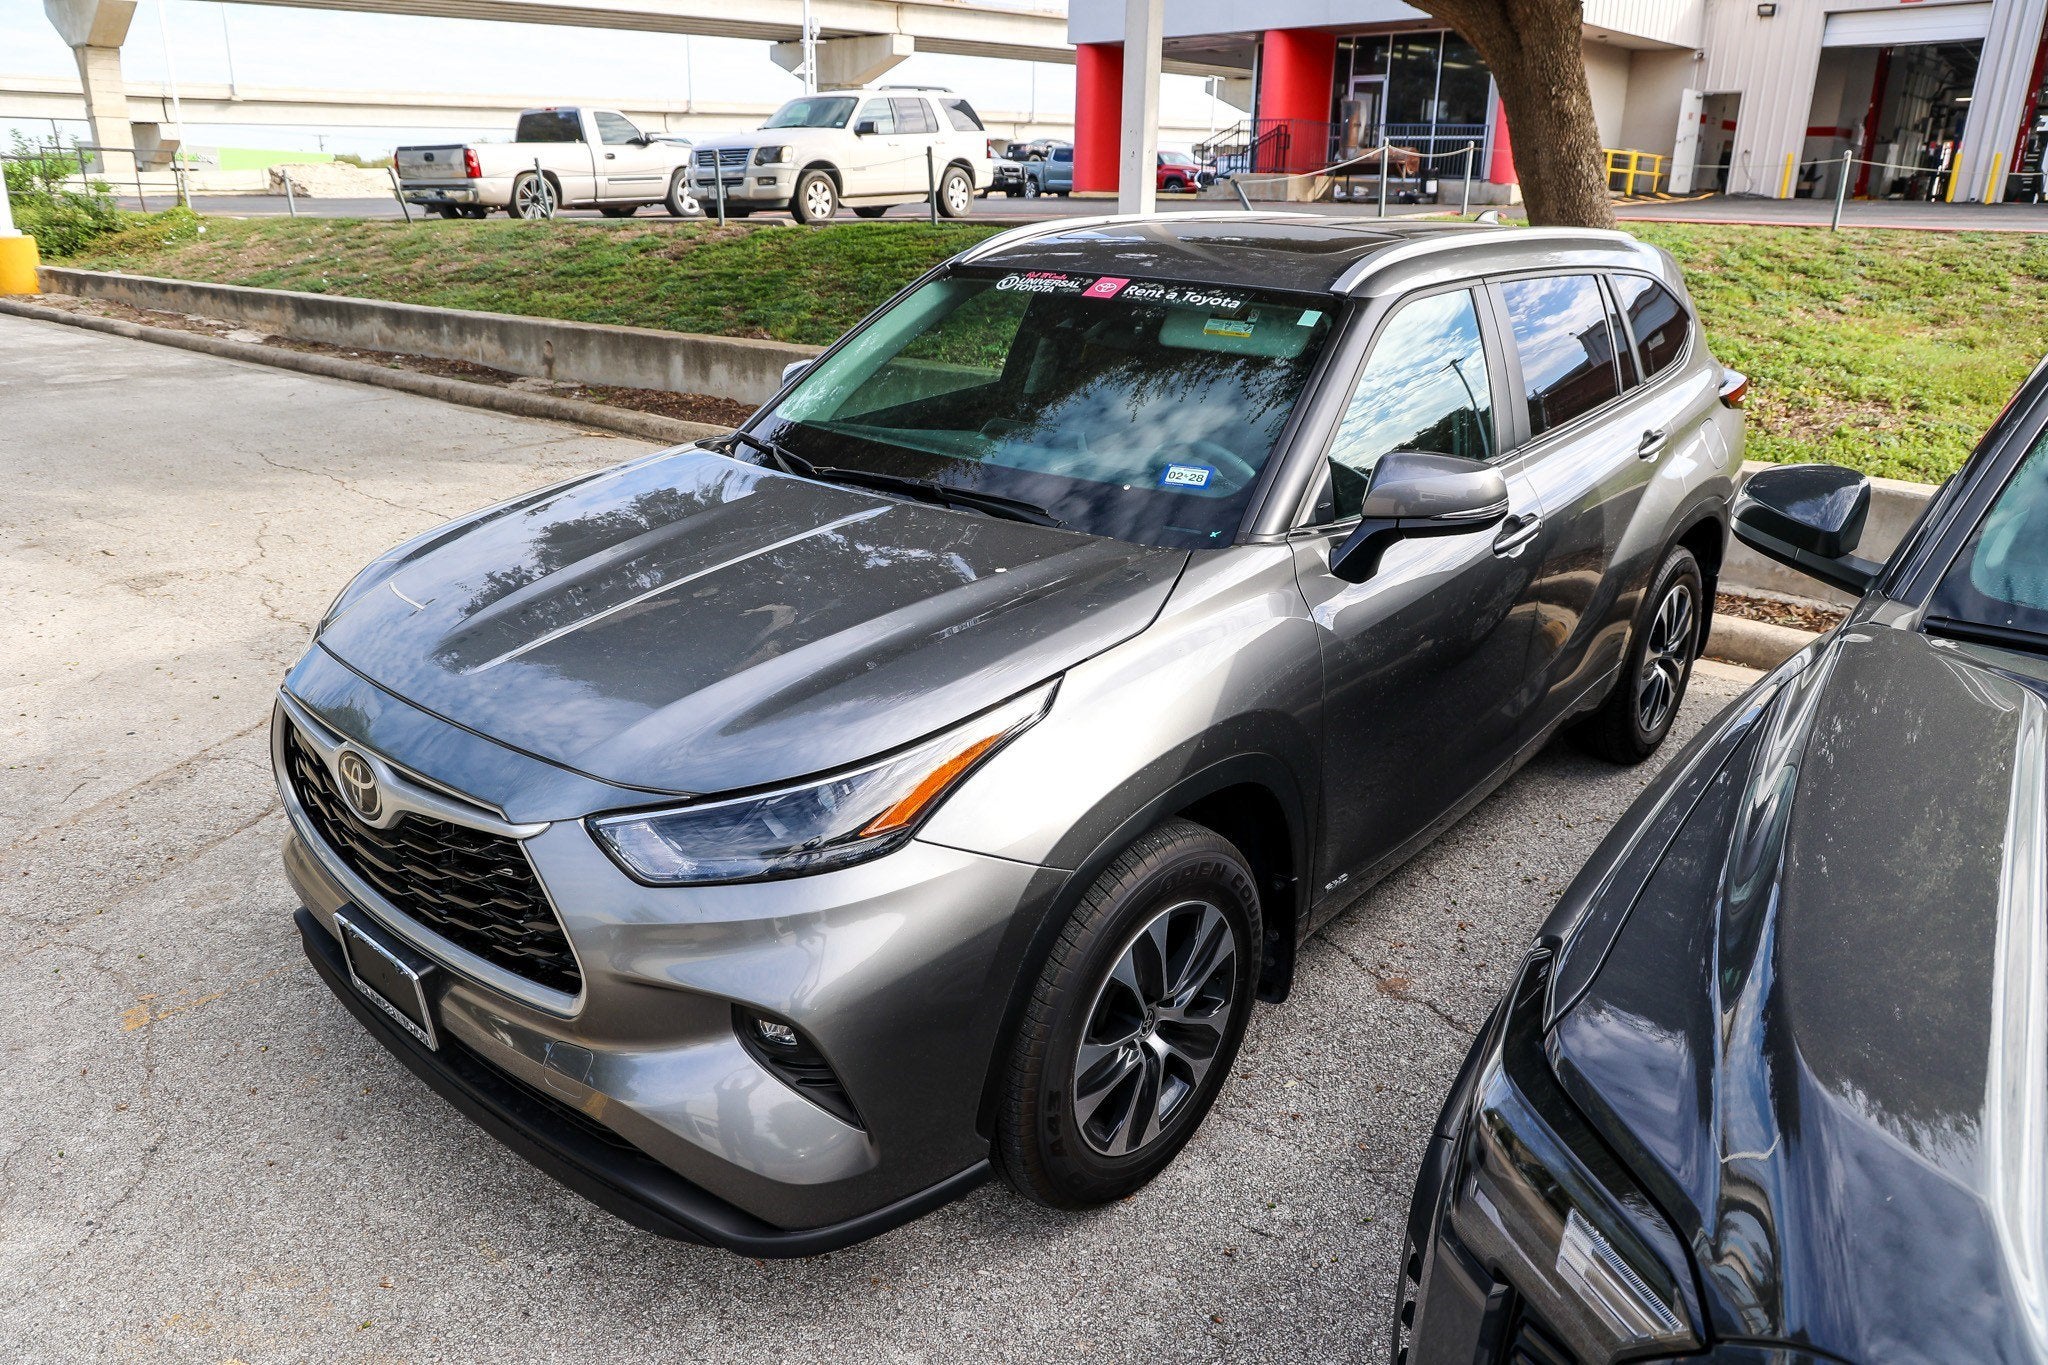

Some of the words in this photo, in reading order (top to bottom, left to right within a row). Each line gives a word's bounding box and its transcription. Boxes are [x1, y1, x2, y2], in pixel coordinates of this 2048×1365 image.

[1013, 284, 1055, 293] TOYOTA
[1019, 278, 1081, 289] UNIVERSAL
[1123, 285, 1165, 298] Rent
[1165, 291, 1179, 300] a
[1180, 291, 1242, 309] Toyota
